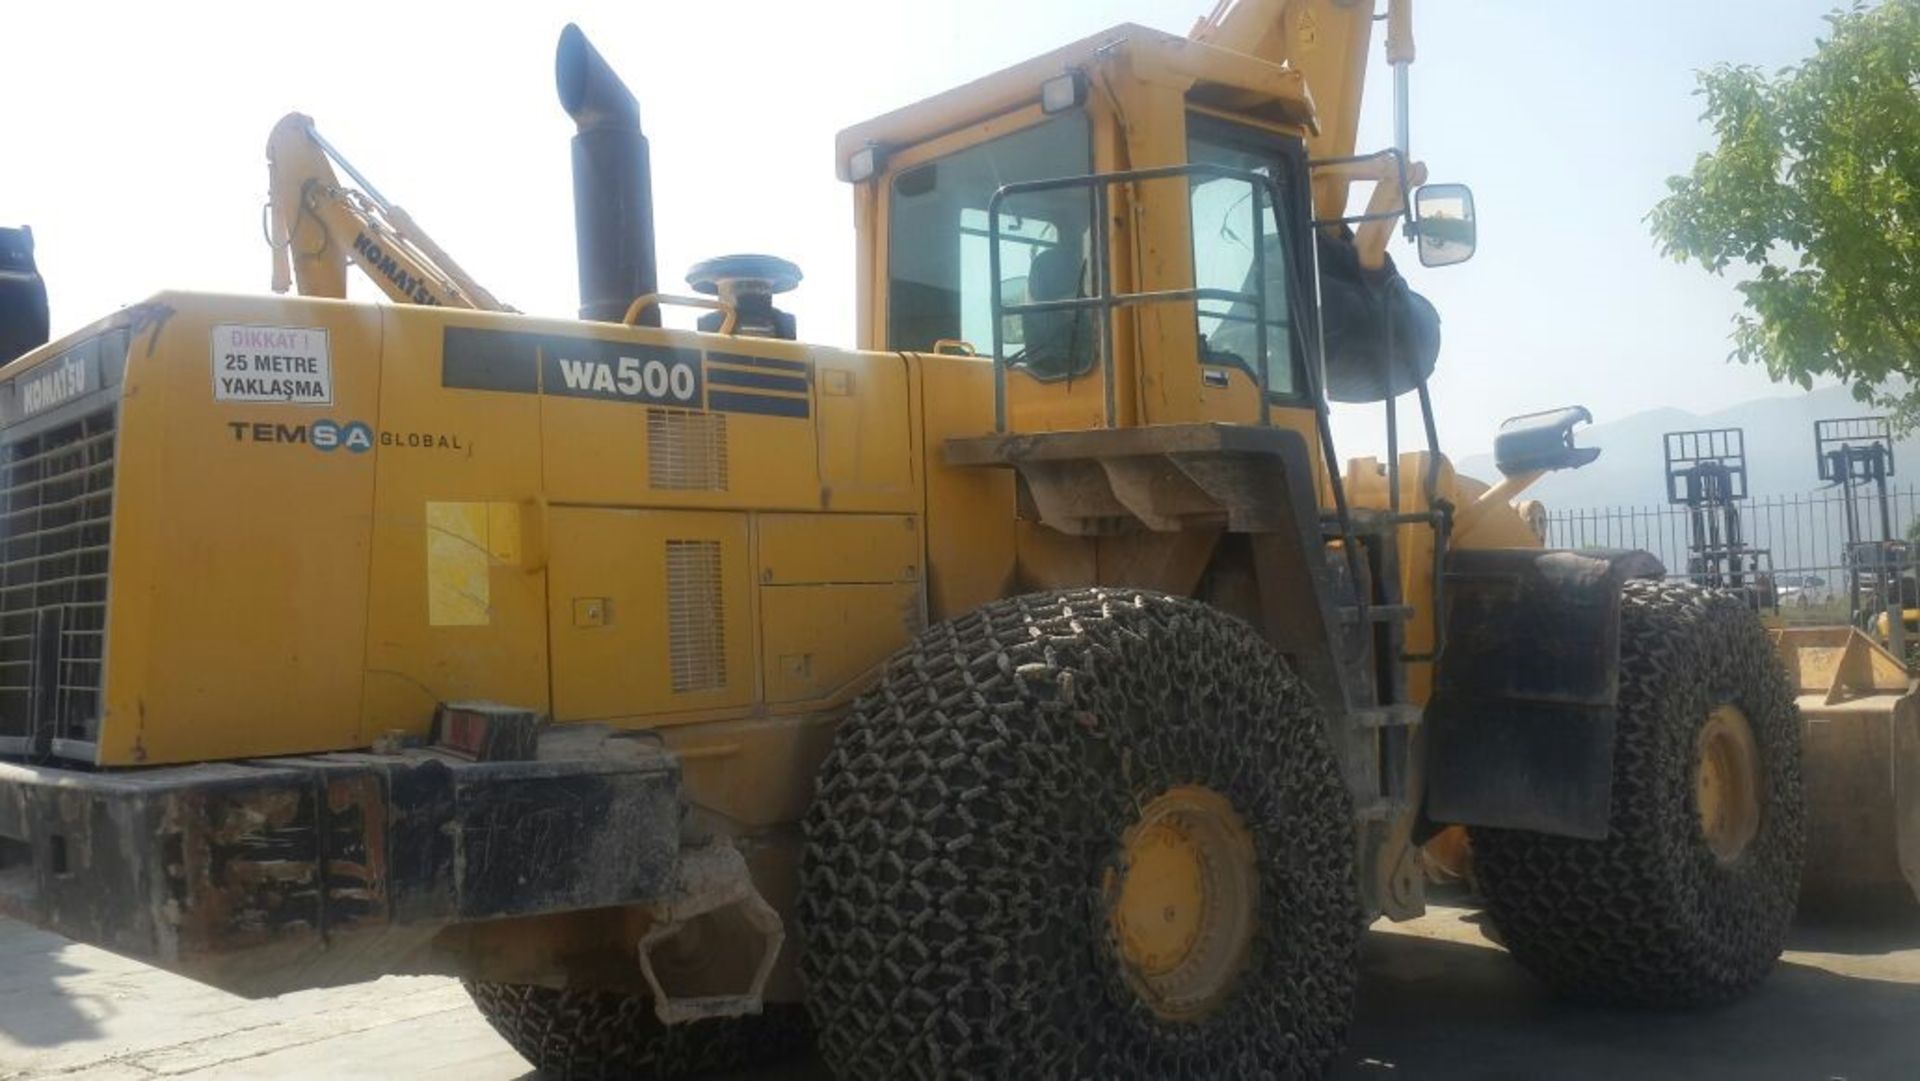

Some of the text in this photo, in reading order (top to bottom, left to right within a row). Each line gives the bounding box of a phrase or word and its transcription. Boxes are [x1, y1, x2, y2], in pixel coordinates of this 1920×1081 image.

[225, 354, 318, 374] 25 METRE
[560, 356, 695, 400] WA500
[23, 356, 85, 416] KOMATSU
[221, 378, 325, 401] YAKLAŞMA
[228, 421, 463, 450] TEMSA GLOBAL
